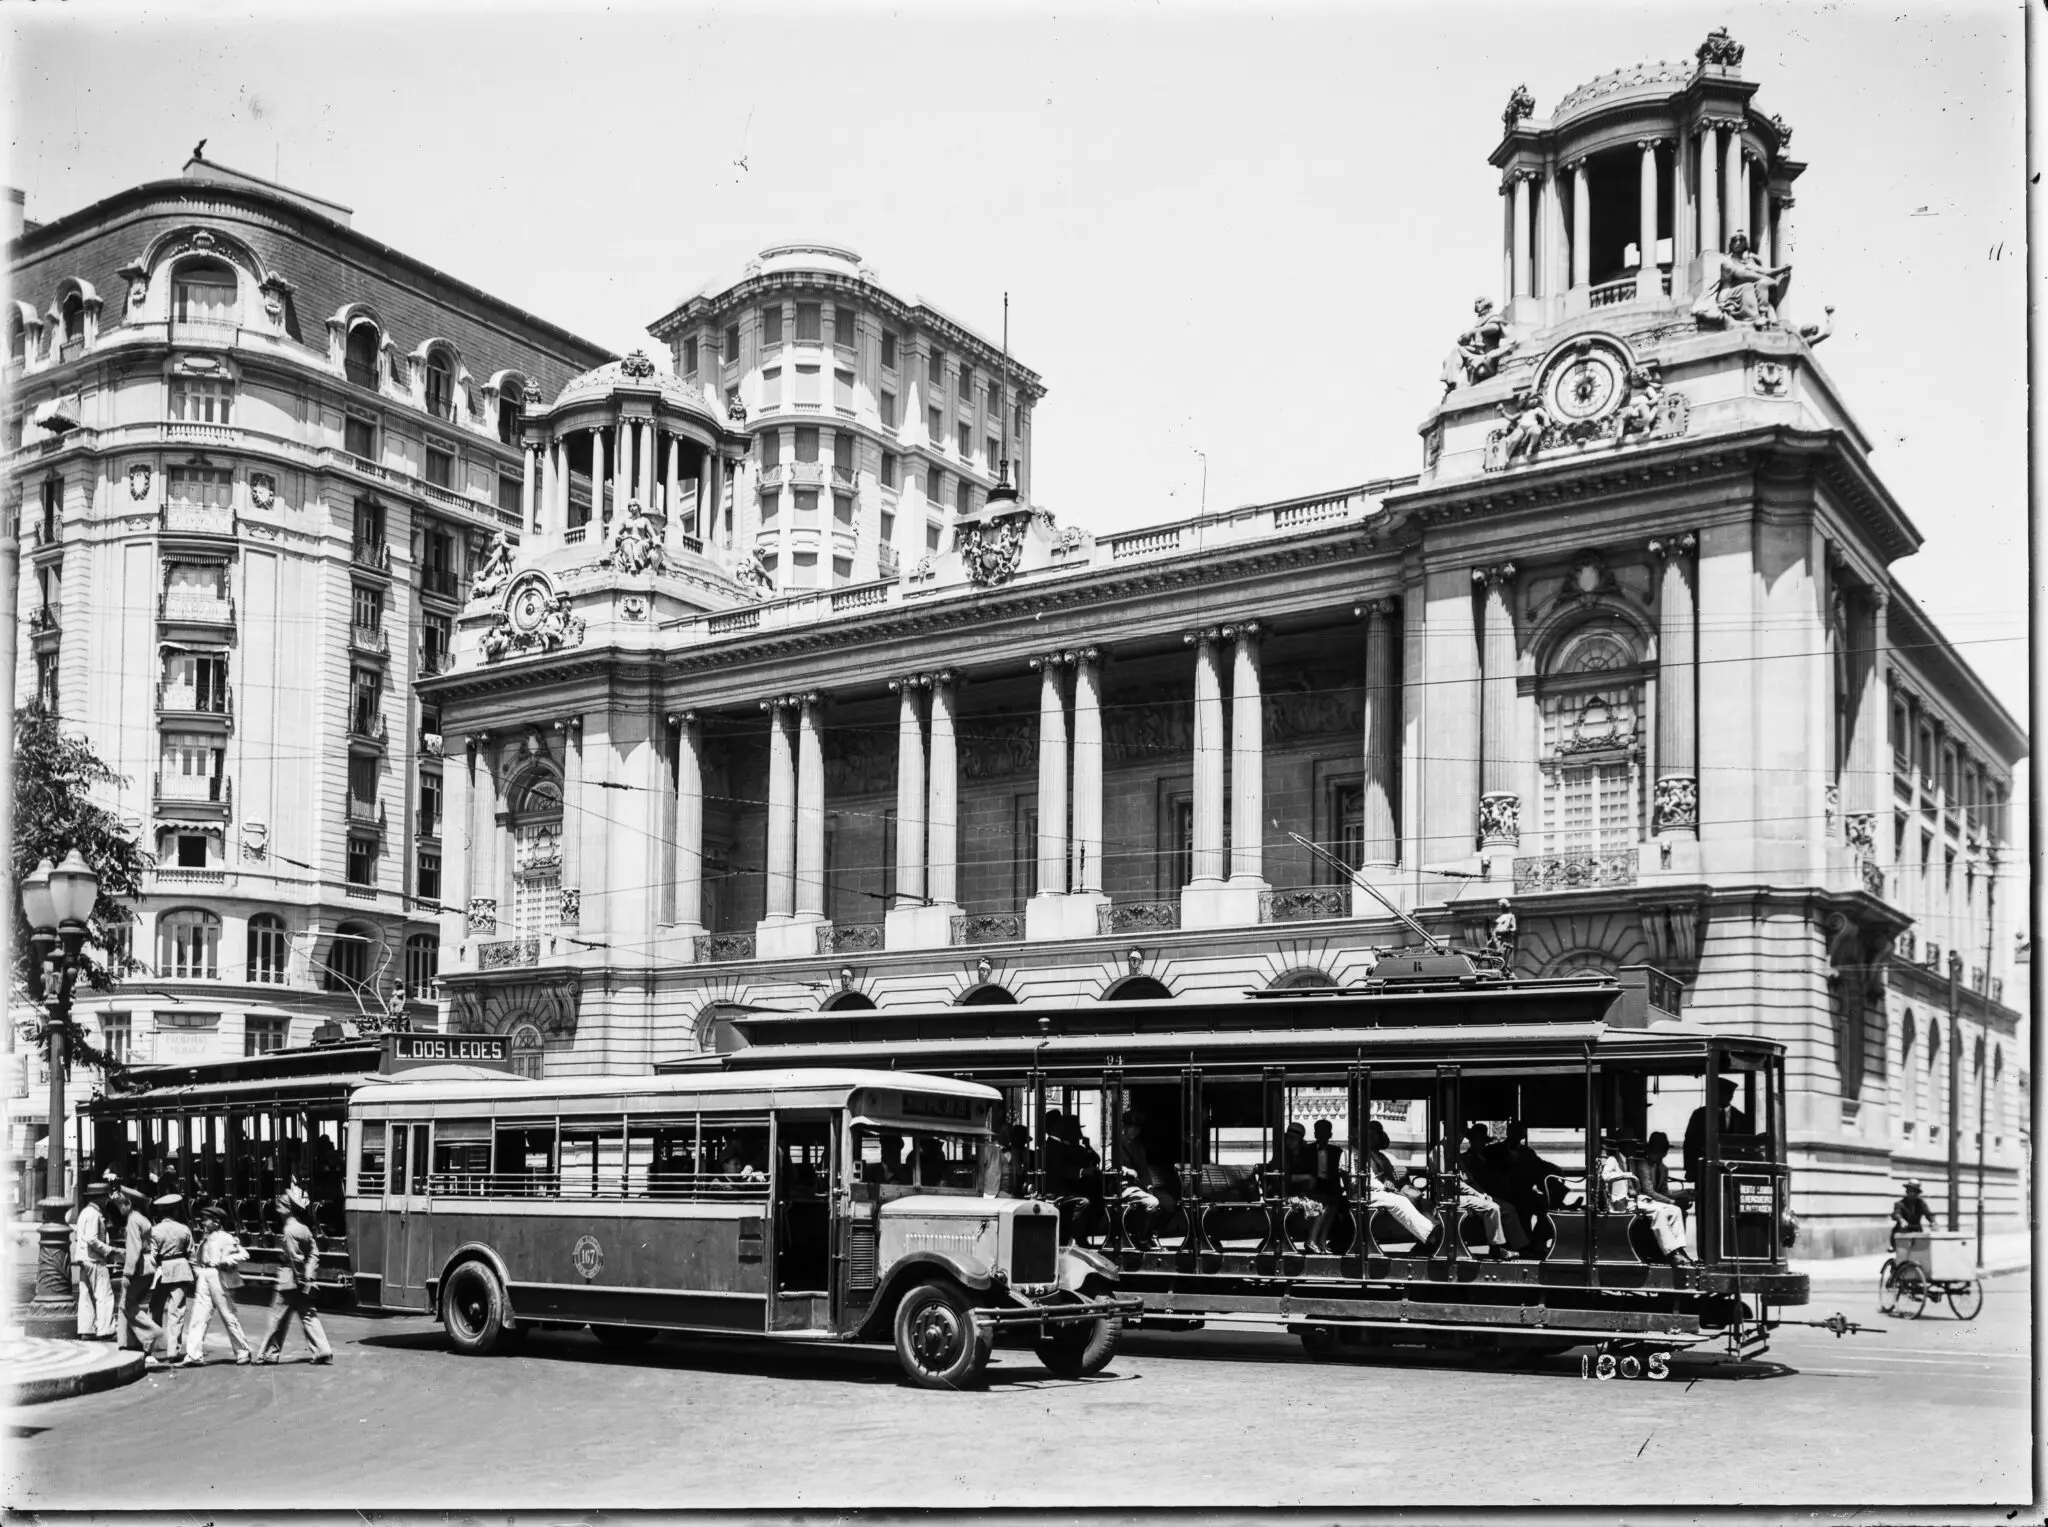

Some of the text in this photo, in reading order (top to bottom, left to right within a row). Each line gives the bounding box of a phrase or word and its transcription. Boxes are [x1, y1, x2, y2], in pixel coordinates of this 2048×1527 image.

[396, 1039, 411, 1058] L.
[413, 1041, 446, 1058] DOS
[1106, 1055, 1123, 1066] 94
[581, 1249, 595, 1264] 167
